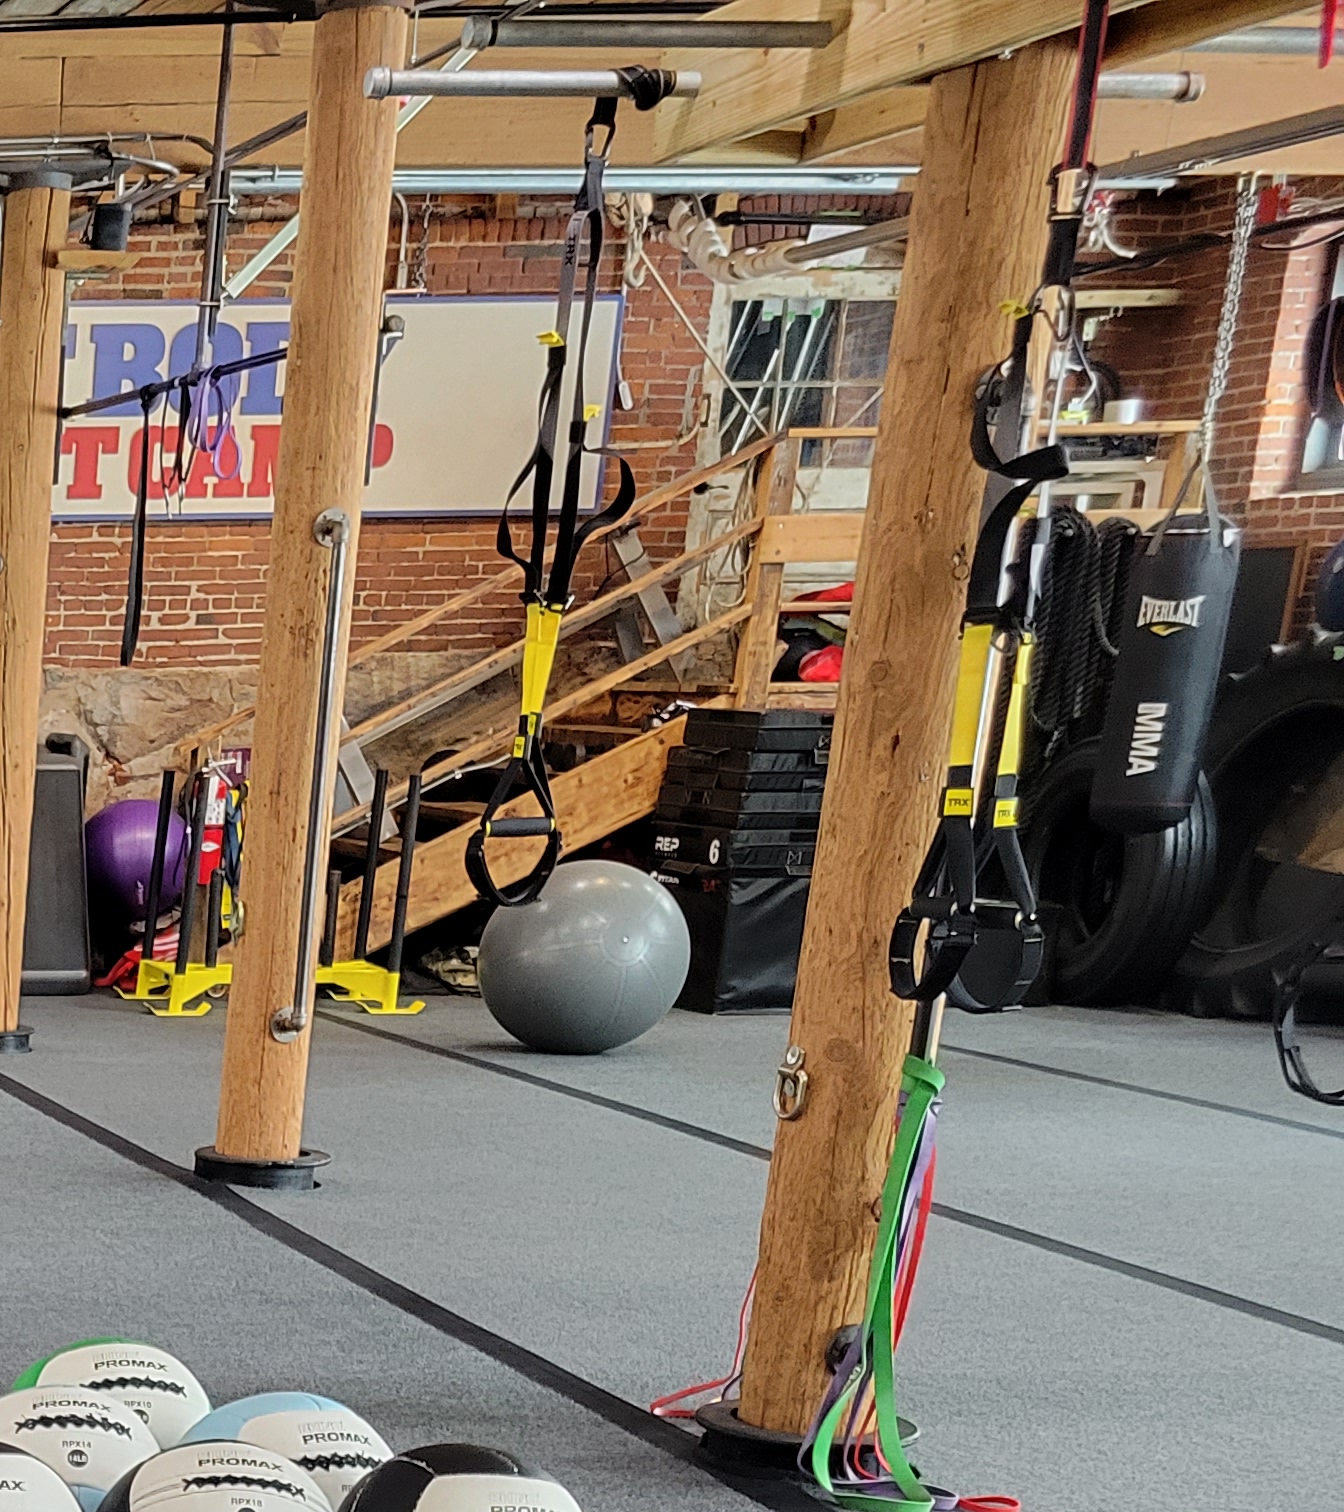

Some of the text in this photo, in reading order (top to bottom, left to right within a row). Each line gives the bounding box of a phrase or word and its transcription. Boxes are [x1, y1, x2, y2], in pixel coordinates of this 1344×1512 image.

[1136, 595, 1207, 628] EVERLAST
[1125, 702, 1169, 777] MMA
[948, 798, 970, 807] TRX
[654, 836, 680, 851] REP
[709, 838, 721, 865] 6
[94, 1360, 168, 1372] PROMAX
[32, 1400, 112, 1412] PROMAX
[62, 1440, 92, 1449] RPX14
[301, 1432, 372, 1446] PROMAX
[198, 1457, 284, 1472] PROMAX
